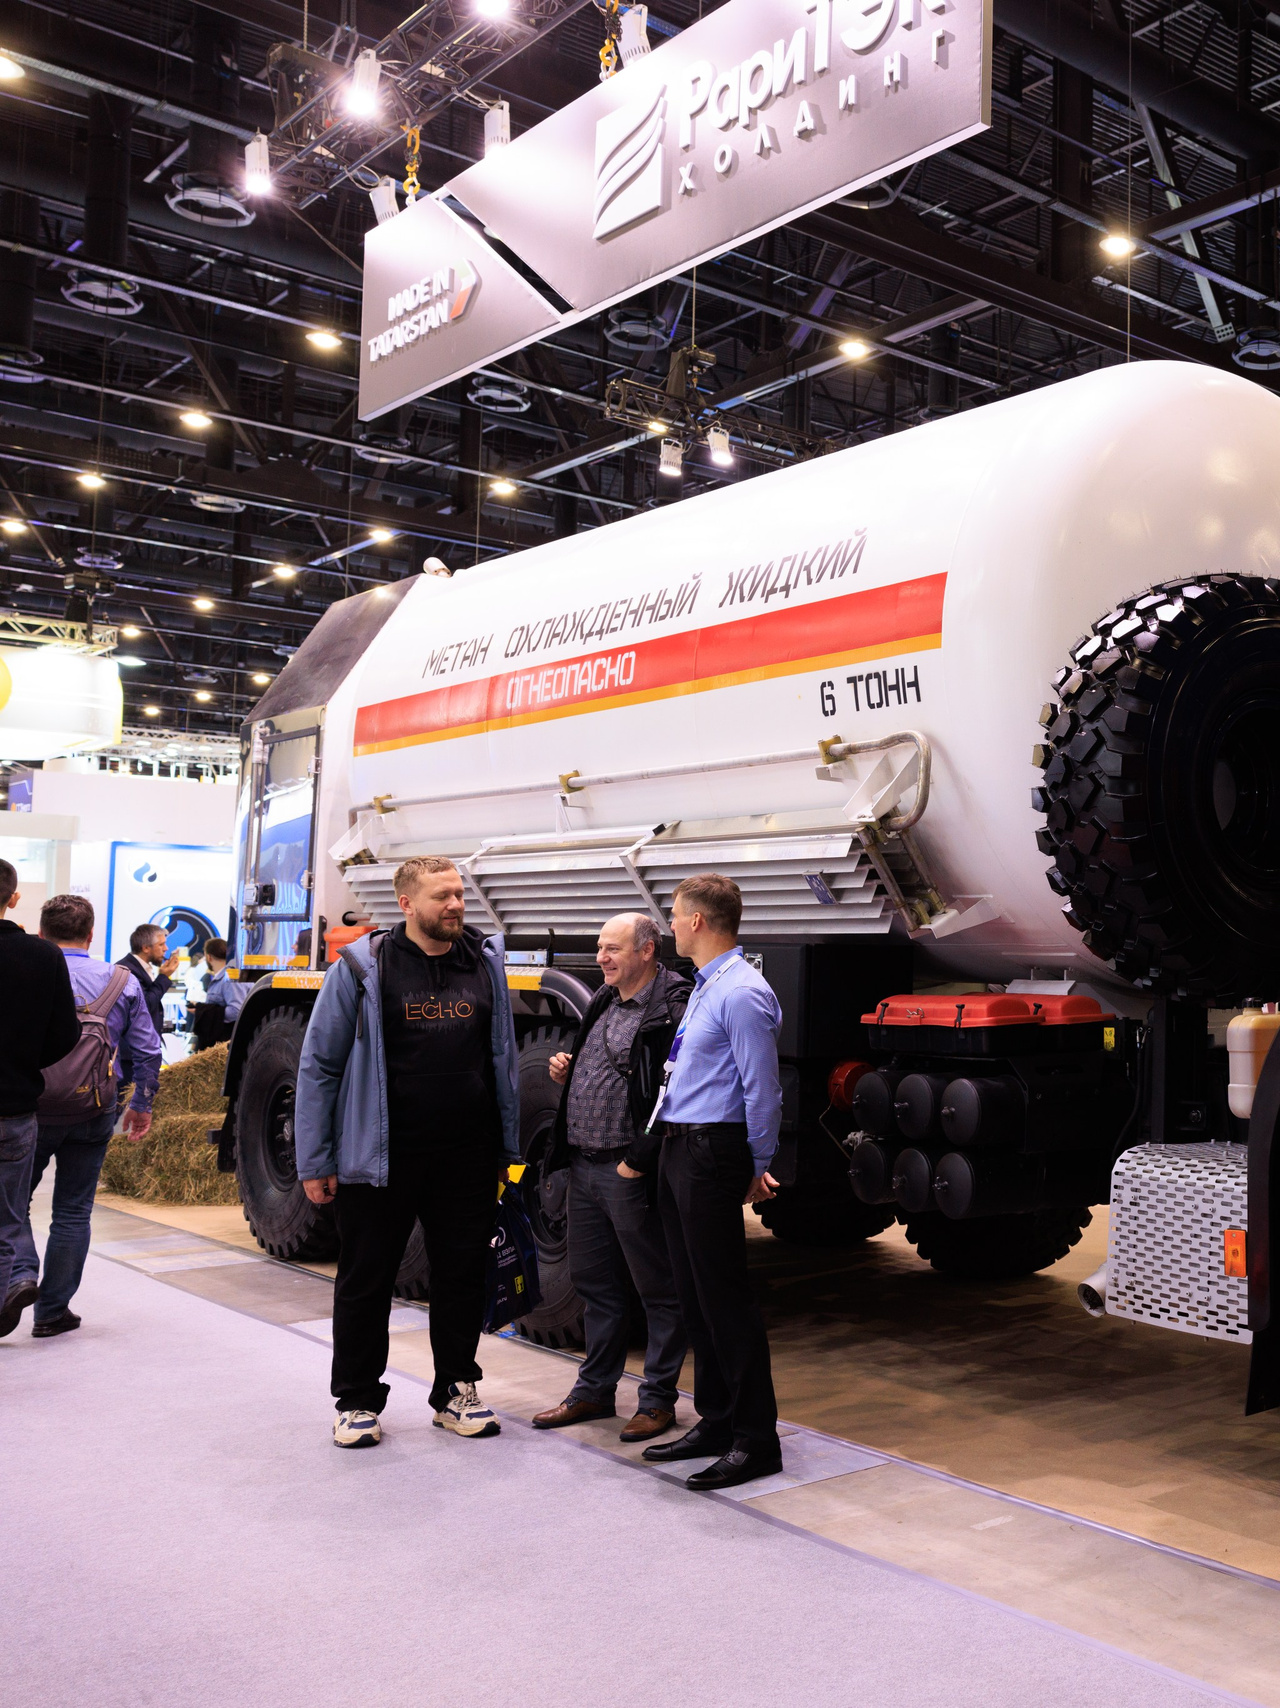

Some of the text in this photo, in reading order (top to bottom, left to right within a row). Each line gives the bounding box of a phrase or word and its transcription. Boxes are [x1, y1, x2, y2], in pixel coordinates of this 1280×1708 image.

[388, 267, 450, 321] MADE IN
[368, 298, 449, 362] TATARSTAN
[422, 527, 867, 678] МЕТАН ОХЛАЖДЕННЫЙ ЖИДКИЙ
[506, 651, 636, 710] ОГНЕОПАСНО
[820, 665, 922, 717] 6 ТОНН
[405, 998, 475, 1020] ECHO
